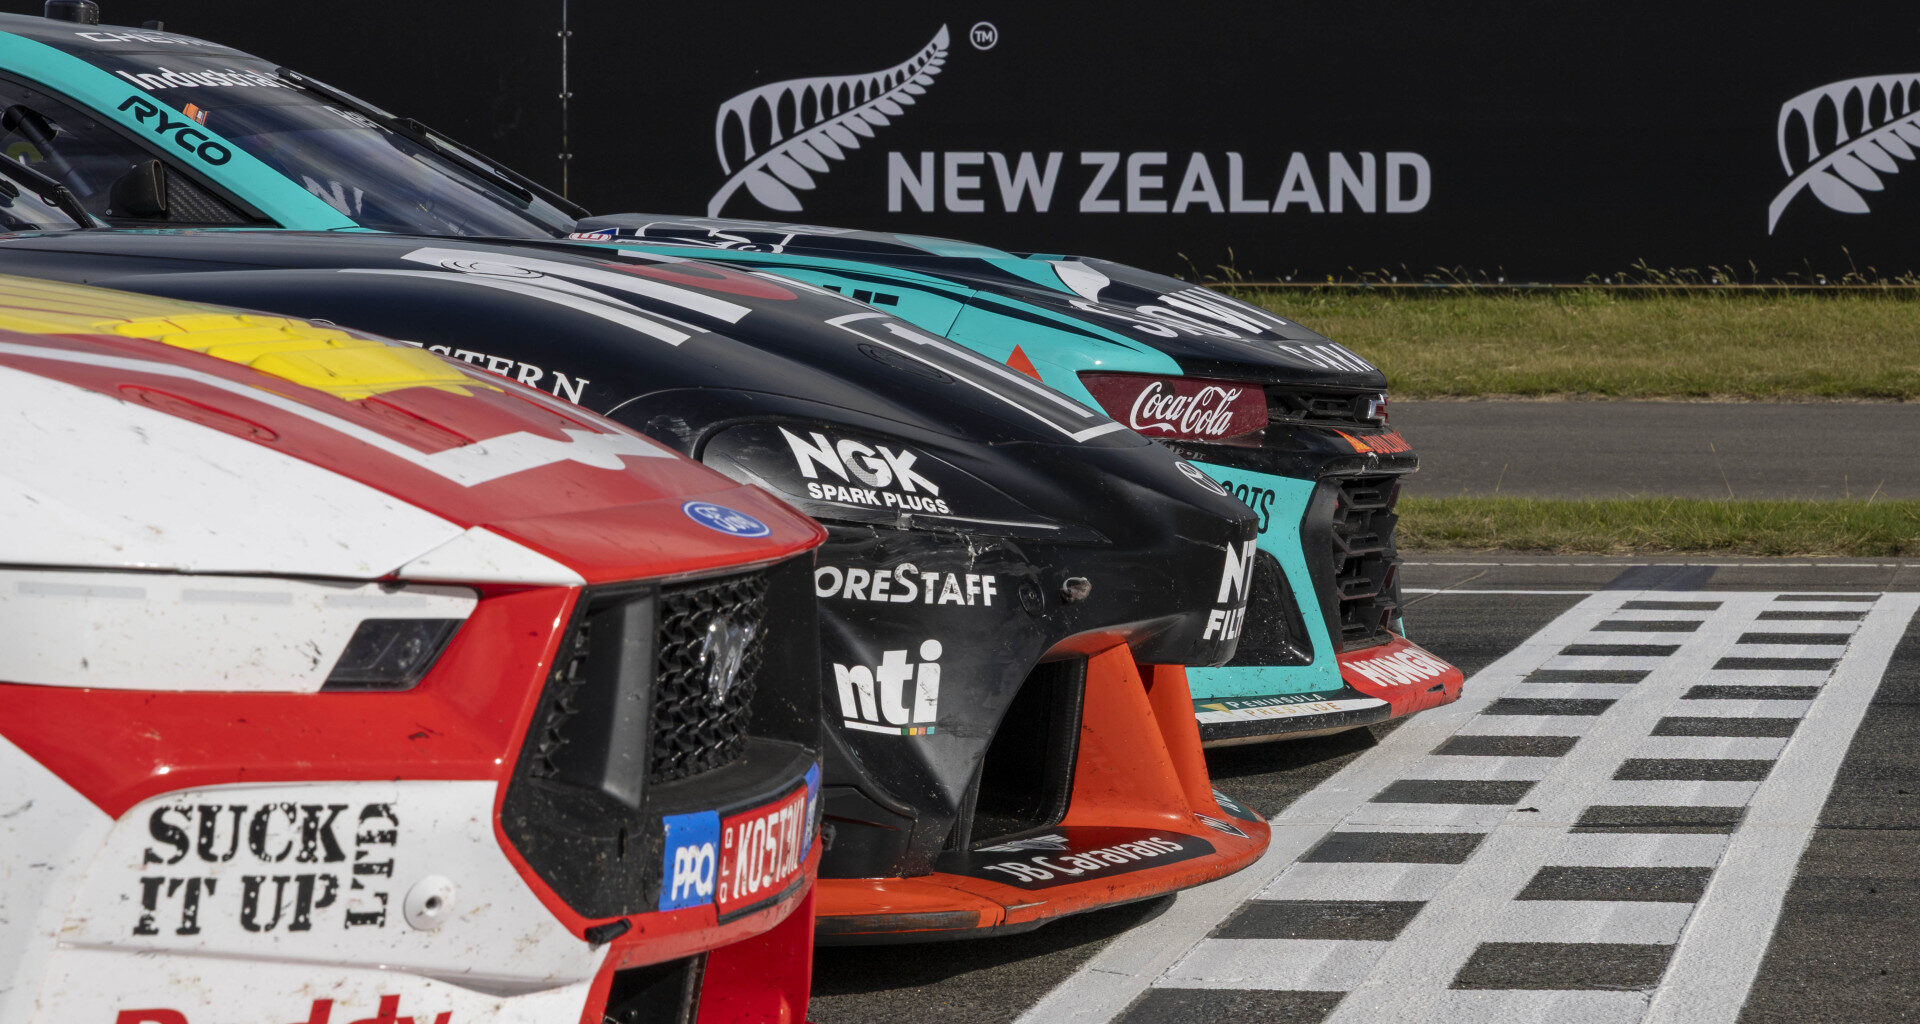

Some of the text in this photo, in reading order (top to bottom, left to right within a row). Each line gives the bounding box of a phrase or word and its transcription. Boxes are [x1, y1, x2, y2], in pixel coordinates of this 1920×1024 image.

[117, 95, 233, 166] RYCO
[888, 151, 1432, 213] NEW ZEALAND
[1129, 381, 1243, 436] Coca-Cola
[777, 425, 940, 497] NGK
[807, 482, 951, 515] SPARK PLUGS
[833, 639, 943, 725] nti
[1342, 648, 1454, 688] HUNGR
[1225, 692, 1328, 709] PENINSULA
[1244, 701, 1342, 717] PRESTIGE
[143, 801, 349, 865] SUCK
[983, 836, 1184, 883] JB Caravans
[671, 842, 716, 902] PPQ
[132, 873, 340, 936] IT UP
